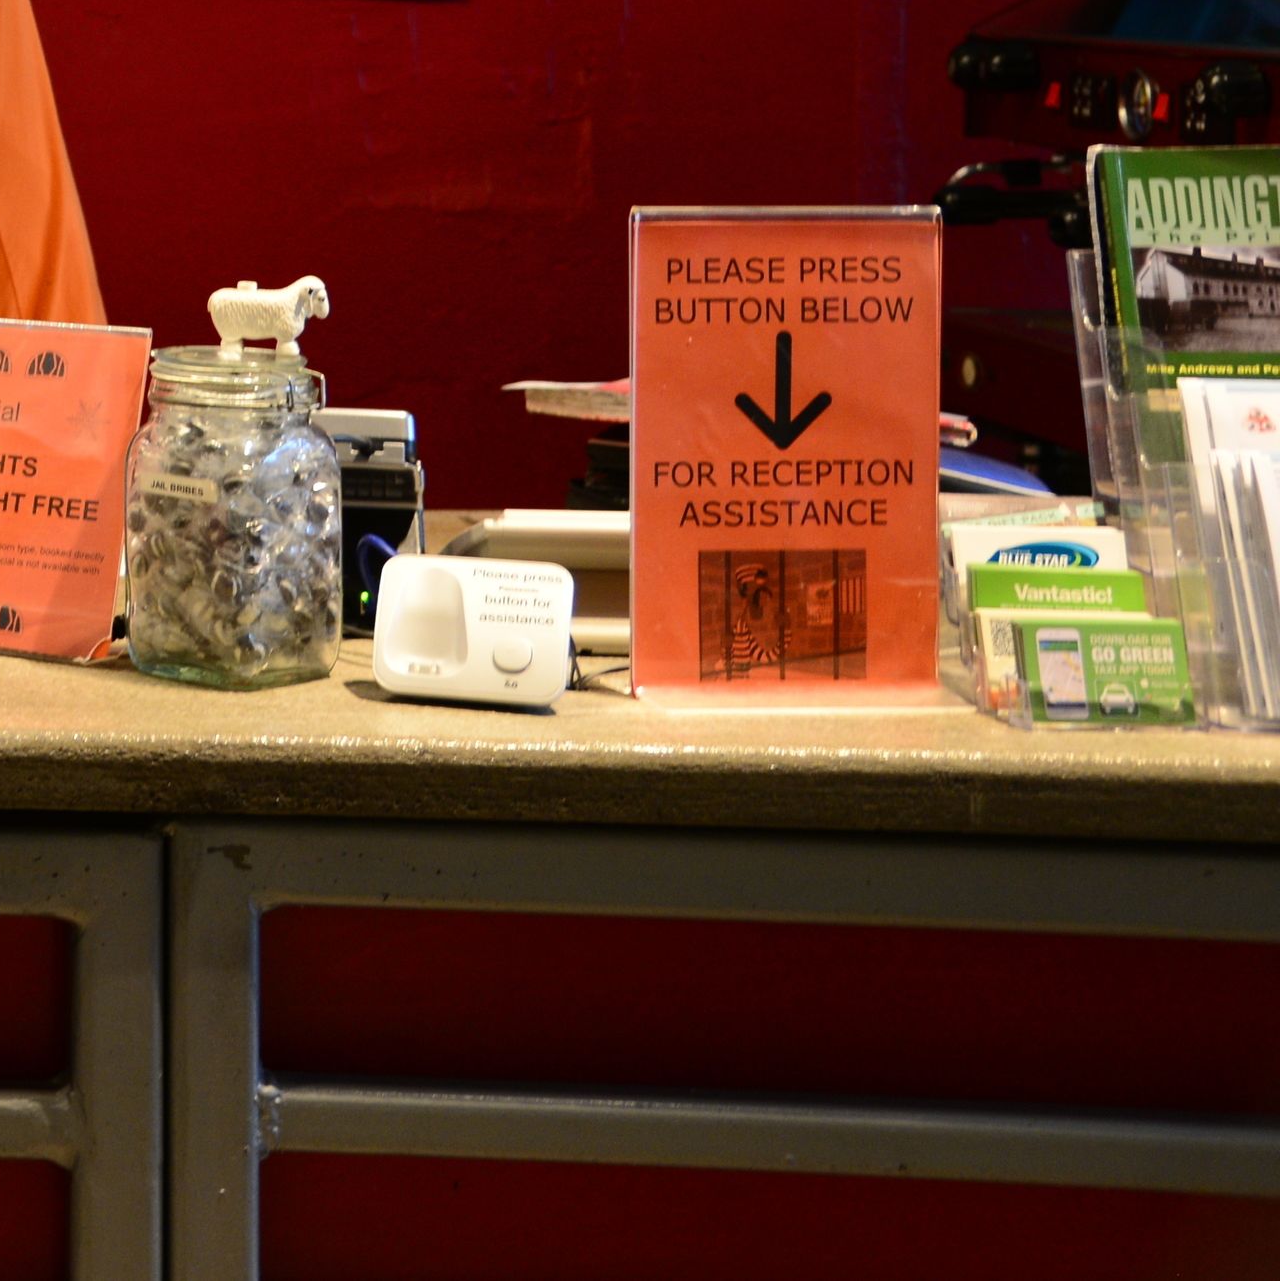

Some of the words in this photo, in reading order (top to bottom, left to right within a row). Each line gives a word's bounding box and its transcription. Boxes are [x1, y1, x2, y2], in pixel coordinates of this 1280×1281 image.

[666, 256, 785, 284] PLEASE
[799, 256, 902, 284] PRESS
[655, 296, 786, 324] BUTTON
[800, 296, 914, 324] BELOW
[1146, 363, 1175, 375] Mike
[1179, 363, 1234, 375] Andrews
[1237, 363, 1260, 375] and
[653, 461, 717, 488] FOR
[731, 460, 914, 487] RECEPTION
[151, 480, 166, 490] JAIL
[170, 483, 204, 496] BRIBES
[32, 494, 100, 521] FREE
[679, 498, 888, 528] ASSISTANCE
[473, 568, 519, 580] Please
[523, 573, 563, 583] press
[484, 594, 528, 607] button
[533, 597, 552, 609] for
[1014, 583, 1113, 606] Vantastic!
[479, 612, 555, 626] assistance
